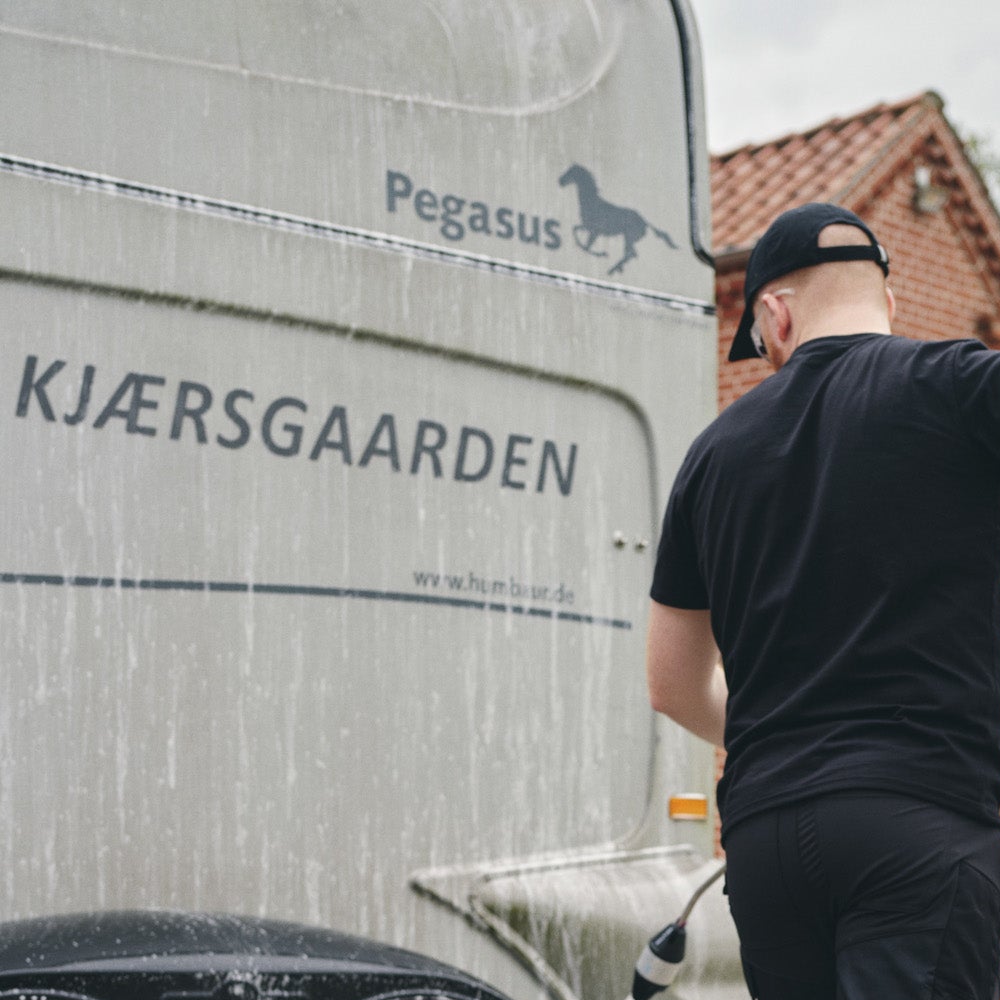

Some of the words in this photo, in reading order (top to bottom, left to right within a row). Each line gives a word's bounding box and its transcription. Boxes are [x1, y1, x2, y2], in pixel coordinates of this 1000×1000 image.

[386, 169, 563, 251] Pegasus
[15, 353, 579, 498] KJÆRSGAARDEN
[413, 571, 575, 604] www.humbur.de
